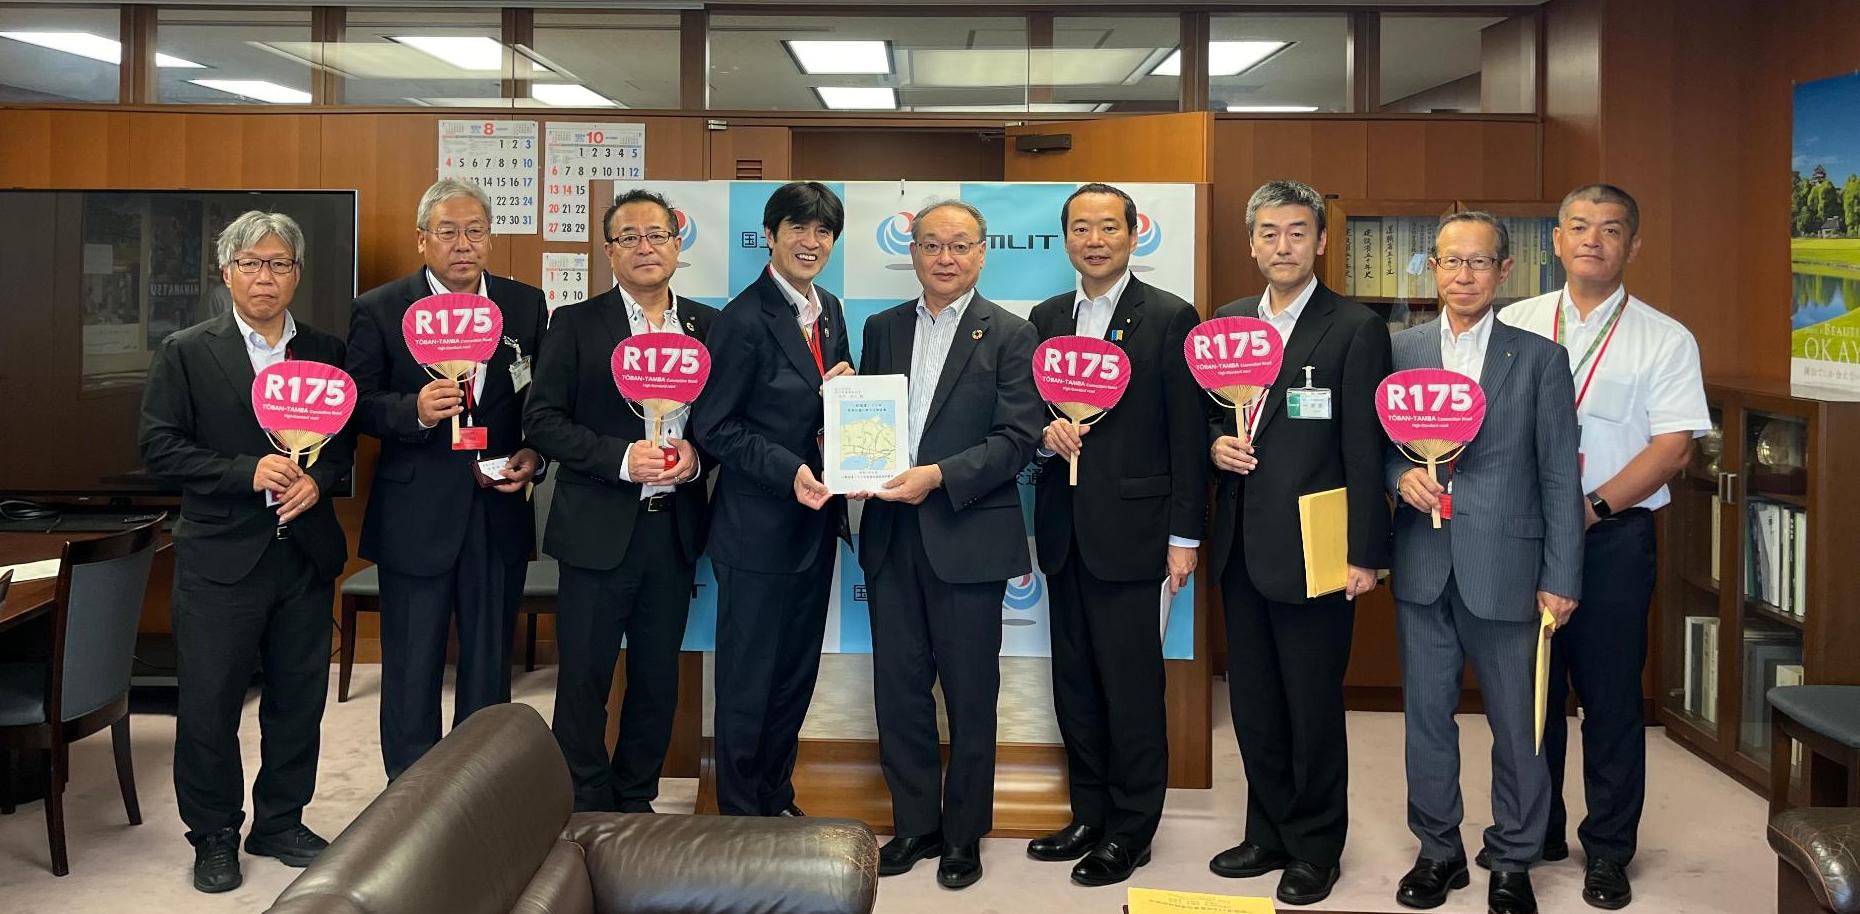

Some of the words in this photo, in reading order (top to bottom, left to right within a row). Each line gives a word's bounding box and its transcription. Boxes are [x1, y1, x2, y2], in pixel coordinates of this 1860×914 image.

[484, 123, 494, 135] 8
[586, 131, 604, 144] 10
[500, 140, 504, 148] 1
[512, 140, 518, 148] 2
[526, 140, 531, 148] 3
[580, 148, 583, 156] 1
[592, 148, 598, 157] 2
[605, 148, 610, 157] 3
[618, 149, 624, 157] 4
[632, 149, 637, 158] 5
[446, 158, 452, 167] 4
[460, 158, 464, 167] 5
[473, 158, 477, 167] 6
[486, 159, 491, 167] 7
[499, 159, 504, 167] 8
[512, 159, 518, 168] 9
[524, 159, 532, 168] 10
[552, 166, 557, 175] 6
[566, 167, 571, 175] 7
[579, 167, 584, 175] 8
[592, 167, 597, 176] 9
[603, 168, 612, 176] 10
[617, 168, 624, 176] 11
[629, 168, 638, 176] 12
[484, 178, 492, 186] 14
[496, 178, 506, 186] 15
[510, 178, 519, 186] 16
[523, 178, 532, 186] 17
[550, 185, 558, 194] 13
[563, 186, 571, 194] 14
[576, 186, 585, 195] 15
[497, 197, 506, 205] 22
[510, 197, 519, 205] 23
[523, 197, 533, 205] 24
[549, 204, 558, 213] 20
[563, 204, 570, 213] 21
[576, 205, 585, 213] 22
[497, 216, 506, 224] 29
[510, 216, 519, 224] 30
[523, 216, 531, 224] 31
[549, 223, 558, 232] 27
[562, 224, 571, 232] 28
[576, 224, 585, 232] 29
[564, 272, 568, 281] 2
[576, 272, 581, 281] 3
[549, 291, 554, 299] 8
[563, 291, 567, 300] 9
[574, 291, 582, 299] 10
[415, 308, 493, 335] R175
[1194, 330, 1270, 359] R175
[623, 346, 699, 374] R175
[1044, 348, 1120, 380] R175
[264, 374, 345, 406] R175
[1387, 384, 1472, 411] R175
